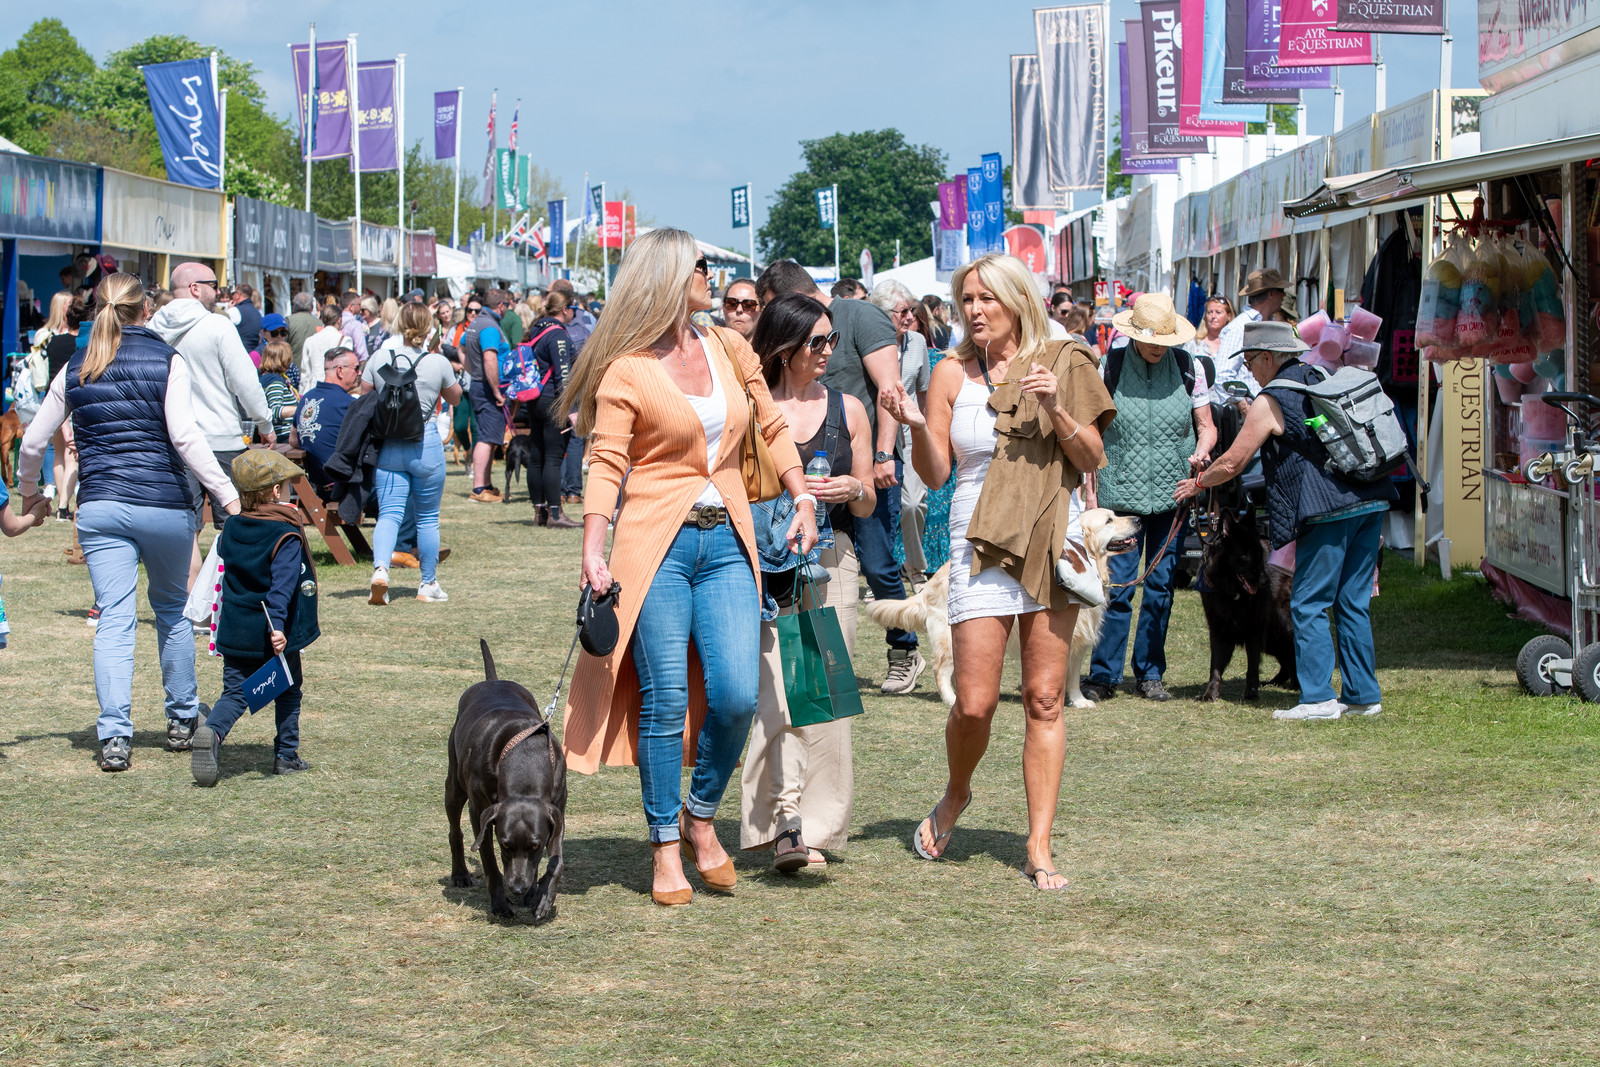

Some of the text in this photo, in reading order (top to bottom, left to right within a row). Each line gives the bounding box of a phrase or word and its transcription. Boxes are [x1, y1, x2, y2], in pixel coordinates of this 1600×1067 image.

[1348, 2, 1433, 19] EQUESTRIAN
[1304, 28, 1326, 39] AYR
[1086, 9, 1103, 88] COOPER
[1288, 36, 1363, 54] EQUESTRIAN
[1253, 62, 1323, 78] EQUESTRIAN
[1154, 133, 1204, 145] EQUESTRIAN
[1, 175, 55, 219] MINTON
[1096, 281, 1121, 298] SAE
[1453, 362, 1481, 501] QUESTRIAN
